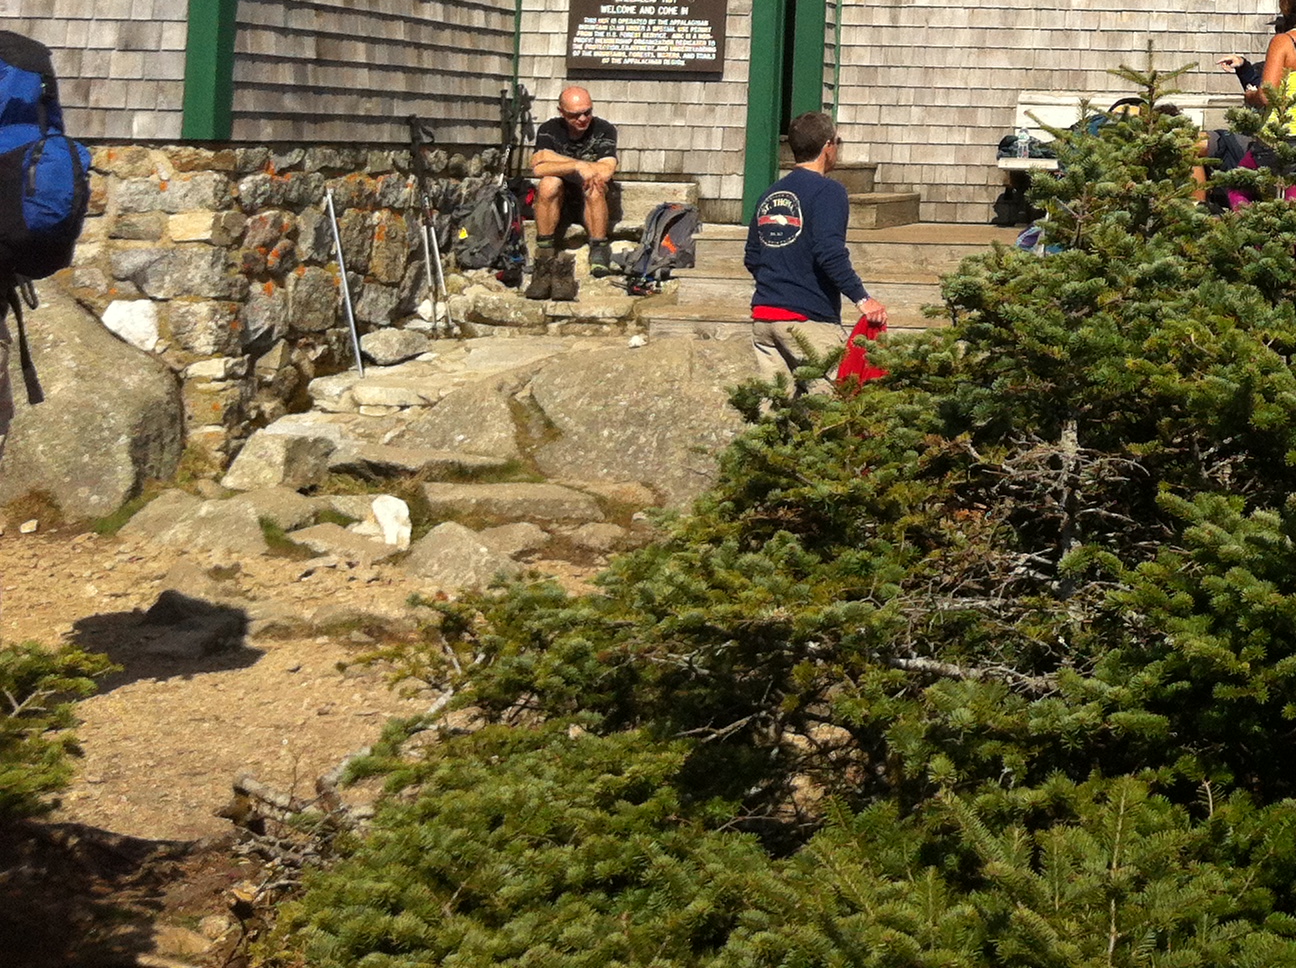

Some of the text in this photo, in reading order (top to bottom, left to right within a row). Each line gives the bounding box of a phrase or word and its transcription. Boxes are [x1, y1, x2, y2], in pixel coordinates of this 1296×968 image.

[600, 5, 689, 16] WELCOME AND COME IN
